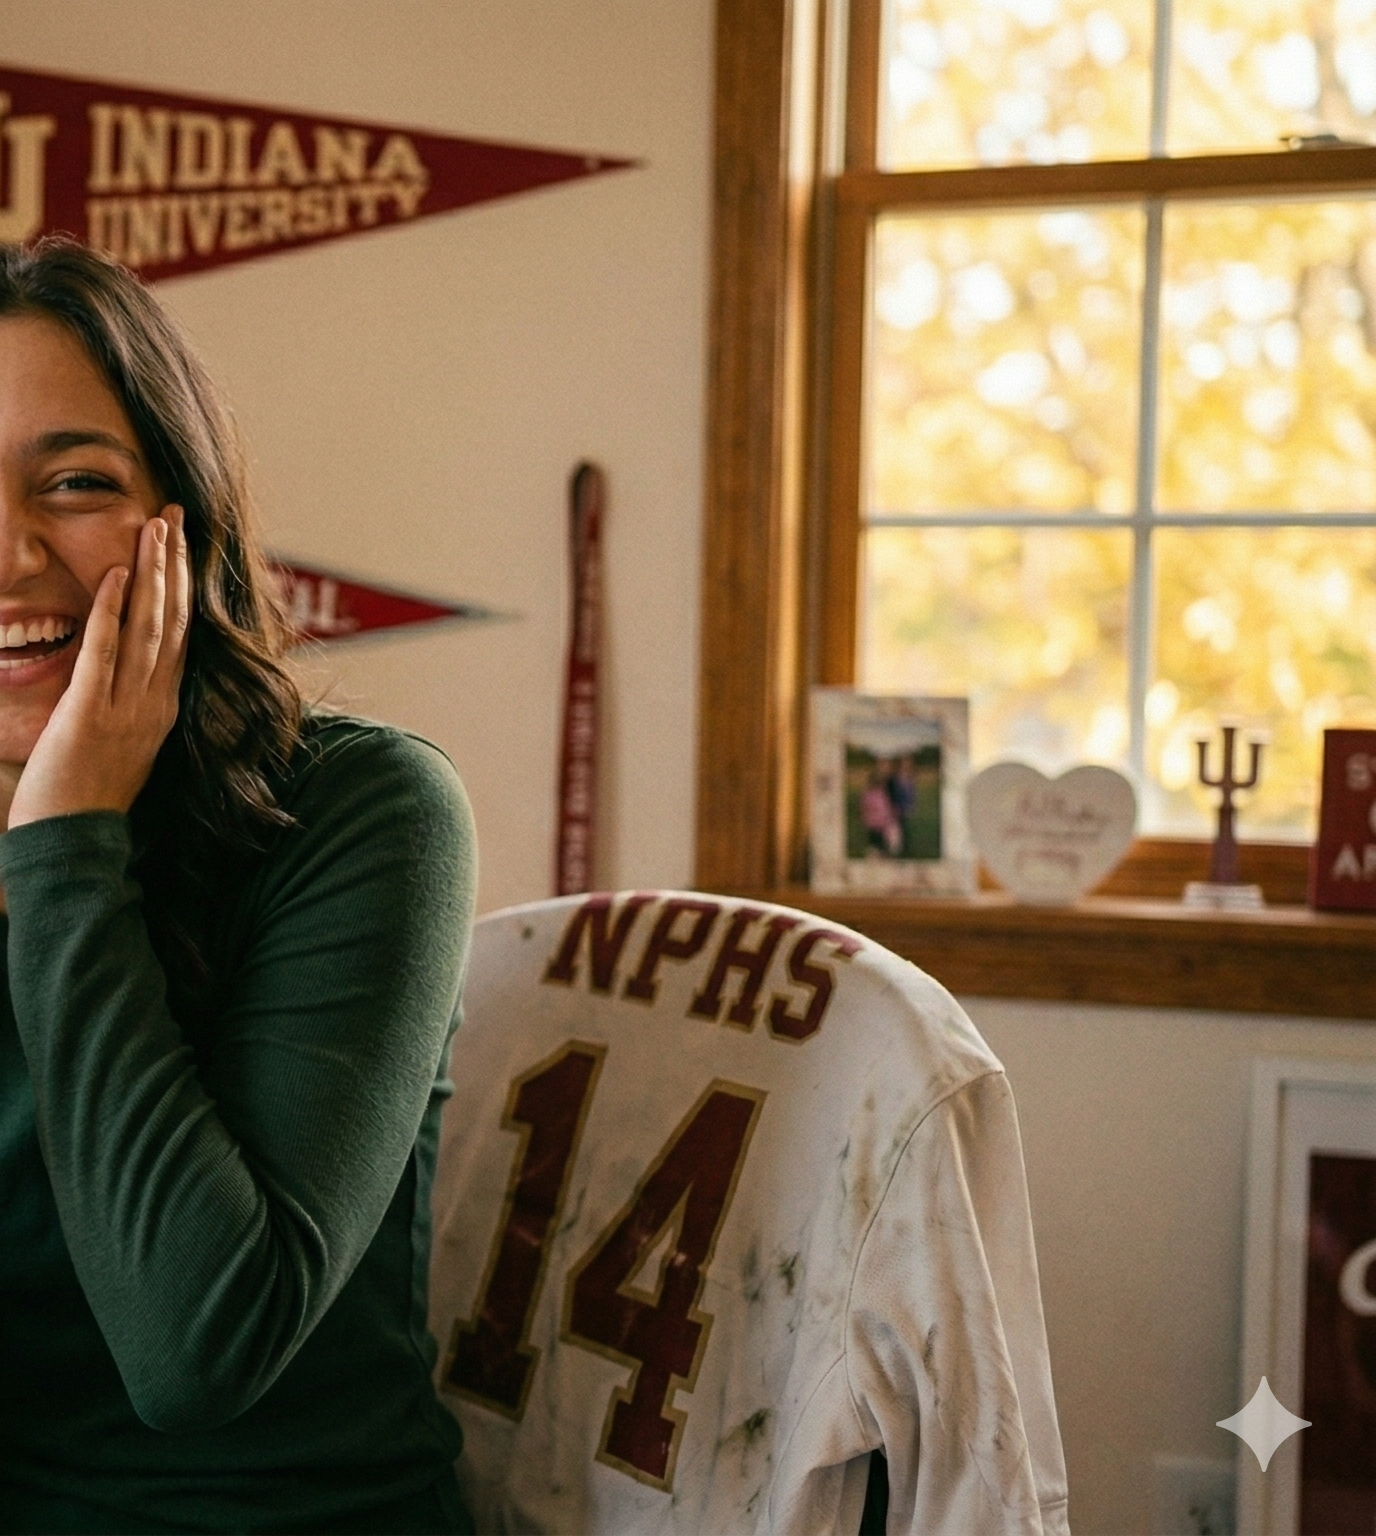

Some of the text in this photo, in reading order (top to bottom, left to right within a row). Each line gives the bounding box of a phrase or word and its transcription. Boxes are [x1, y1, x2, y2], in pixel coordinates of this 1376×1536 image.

[87, 104, 428, 190] INDIANA
[87, 180, 430, 268] UNIVERSITY
[540, 889, 866, 1046] NPHS
[439, 1038, 770, 1496] 14
